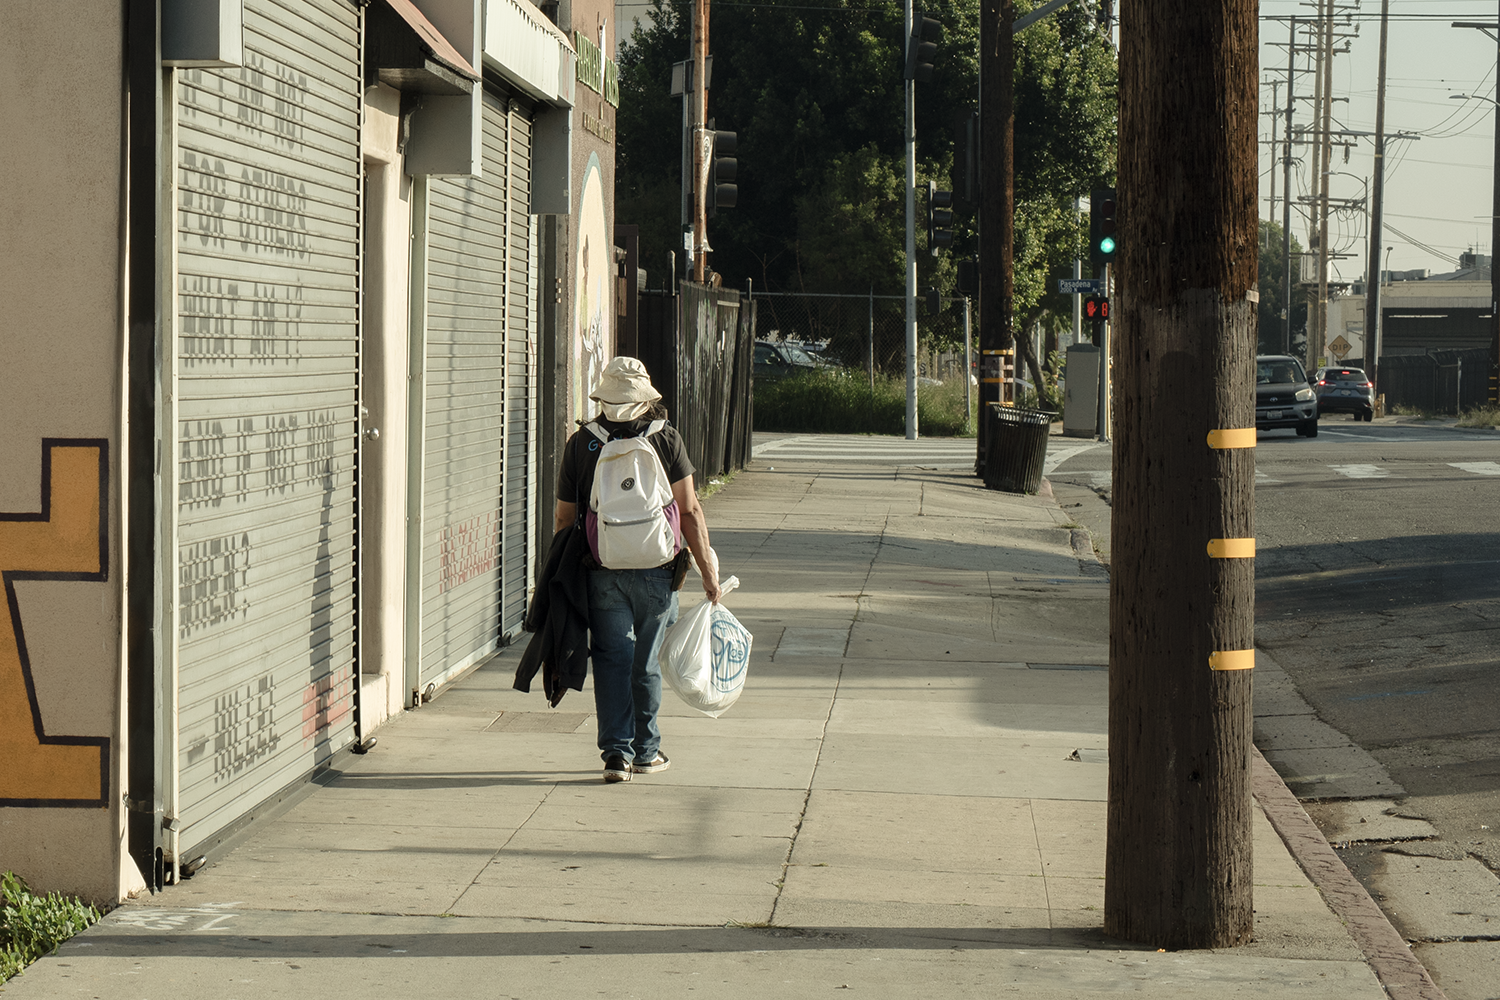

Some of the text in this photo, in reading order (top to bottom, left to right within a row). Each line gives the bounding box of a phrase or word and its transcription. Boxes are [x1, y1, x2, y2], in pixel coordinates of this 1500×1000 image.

[237, 52, 264, 139] AM
[274, 64, 308, 153] NOT
[182, 150, 227, 250] FOR
[182, 277, 239, 368] WHAT
[250, 281, 276, 366] AM
[1102, 302, 1108, 317] 8
[179, 420, 226, 510] AND
[265, 414, 297, 498] NOT
[179, 531, 251, 639] WHEN?
[214, 673, 279, 784] HILLEL
